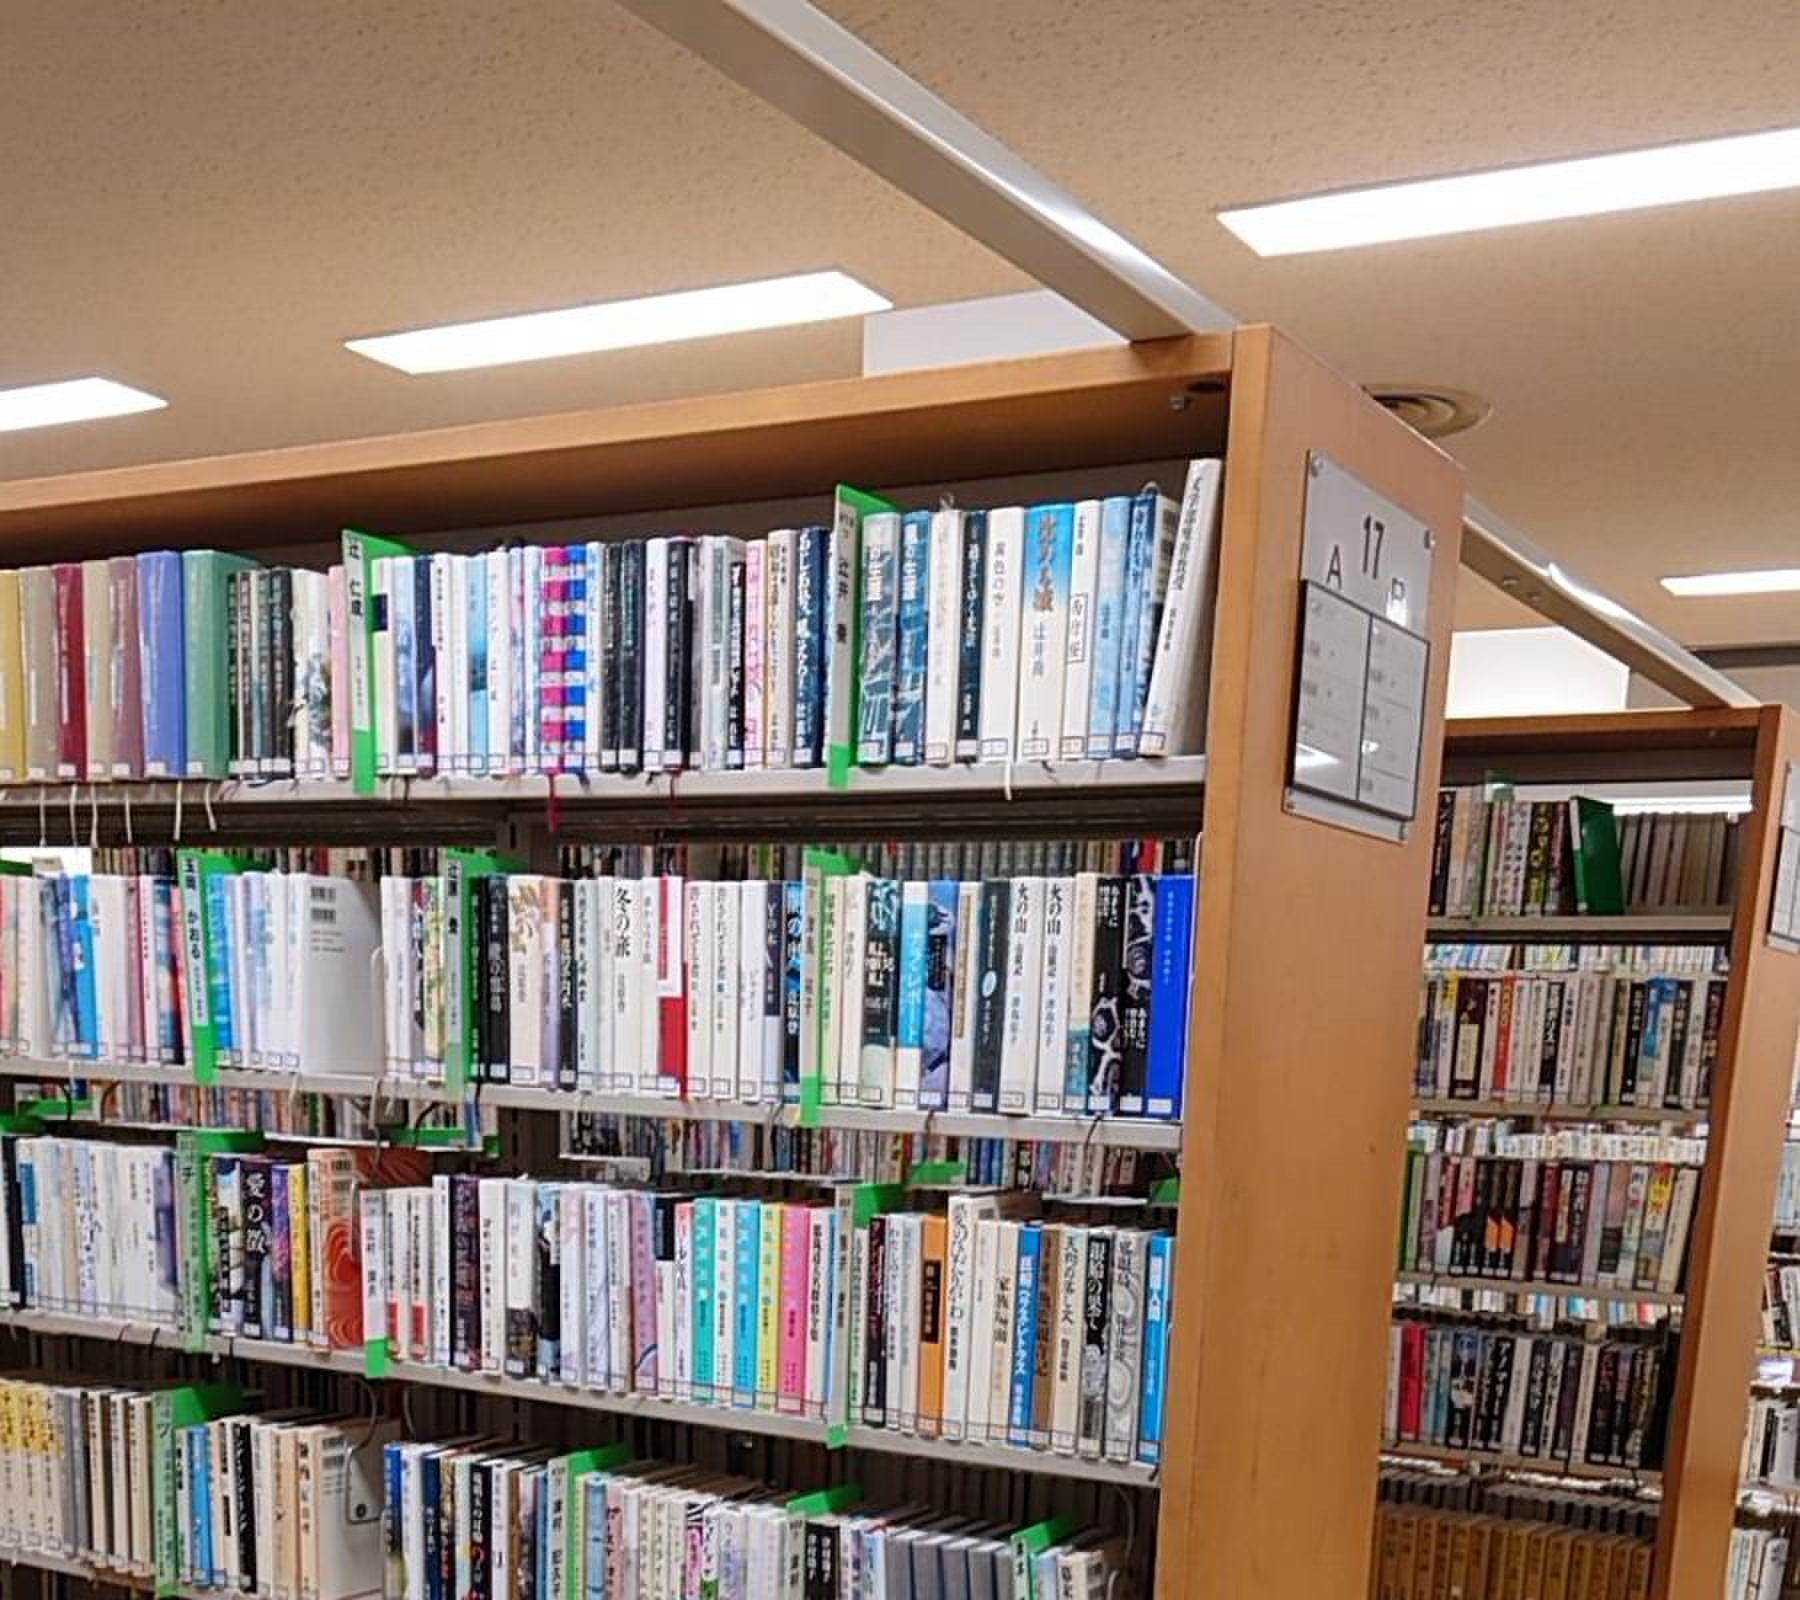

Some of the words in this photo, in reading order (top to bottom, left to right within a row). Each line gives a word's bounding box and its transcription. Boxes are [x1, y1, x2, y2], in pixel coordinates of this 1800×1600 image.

[1325, 543, 1343, 591] A
[1361, 514, 1387, 581] 17
[615, 886, 633, 960] 冬の旅
[1013, 883, 1029, 935] 火の山
[1046, 884, 1061, 936] 火の山
